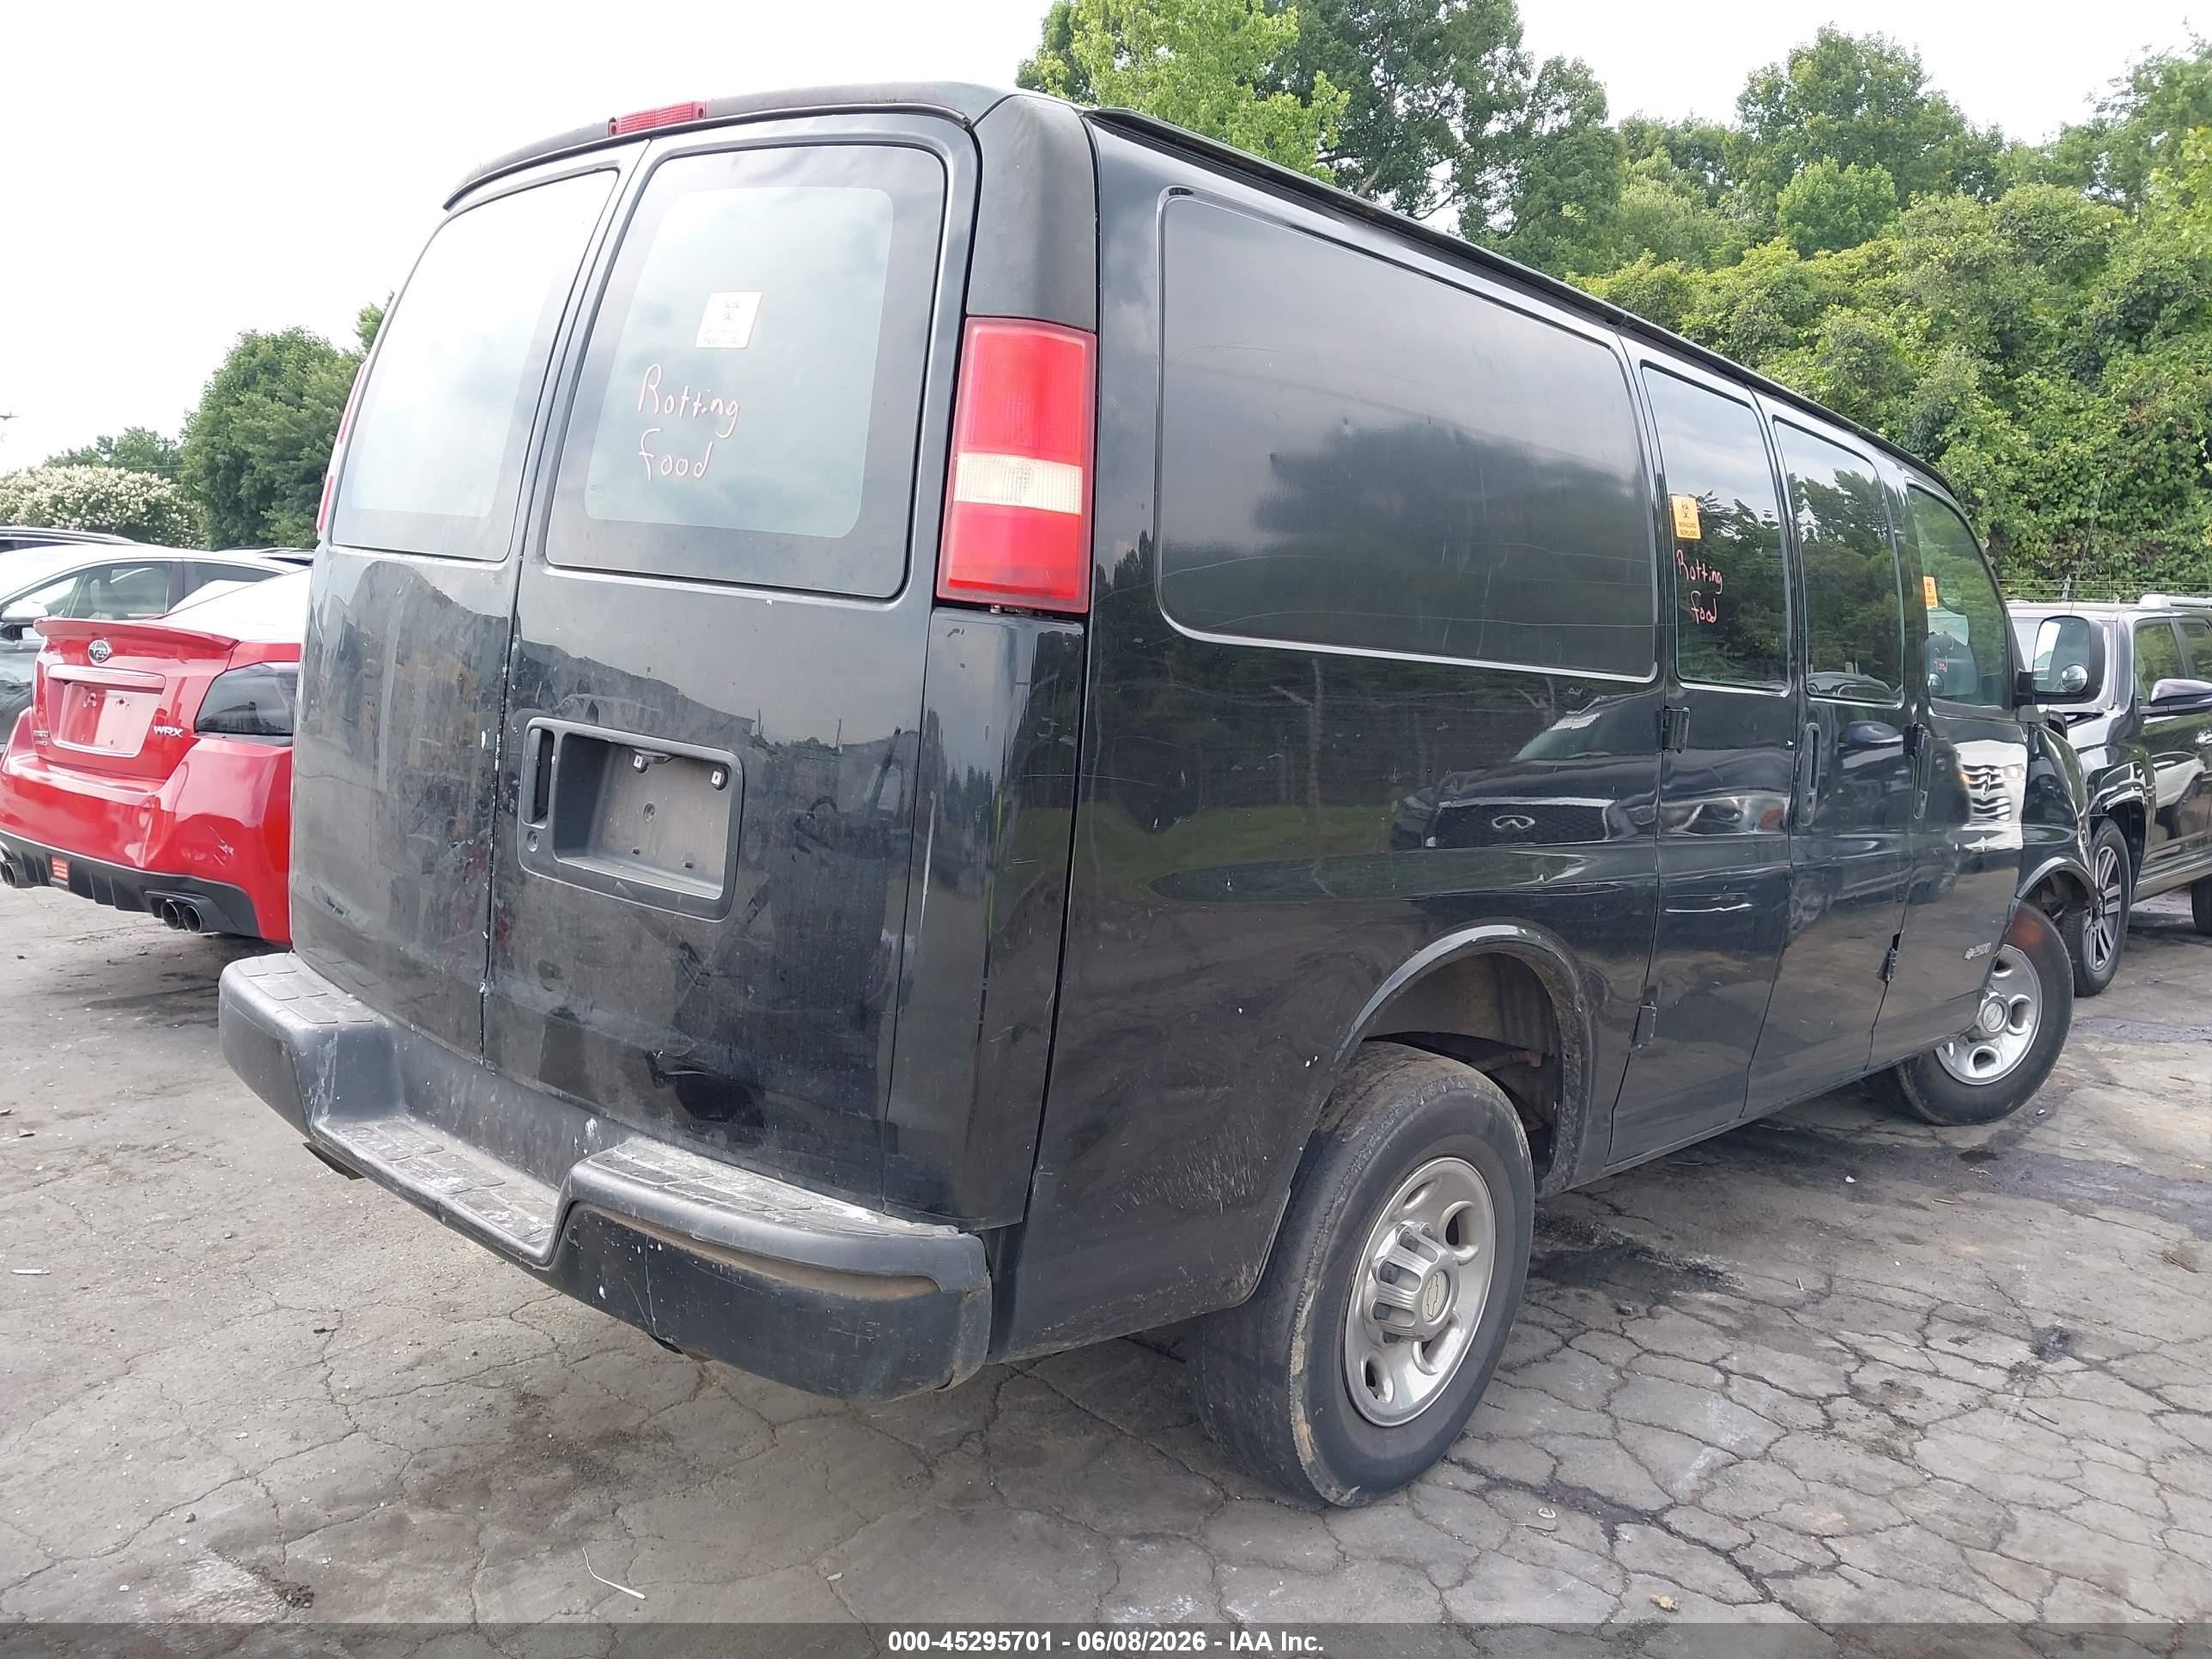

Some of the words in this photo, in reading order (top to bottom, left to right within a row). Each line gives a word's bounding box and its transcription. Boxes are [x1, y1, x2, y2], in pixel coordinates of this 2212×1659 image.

[638, 363, 740, 439] Rotting
[1676, 549, 1723, 595] Rotting
[153, 725, 185, 738] WRX
